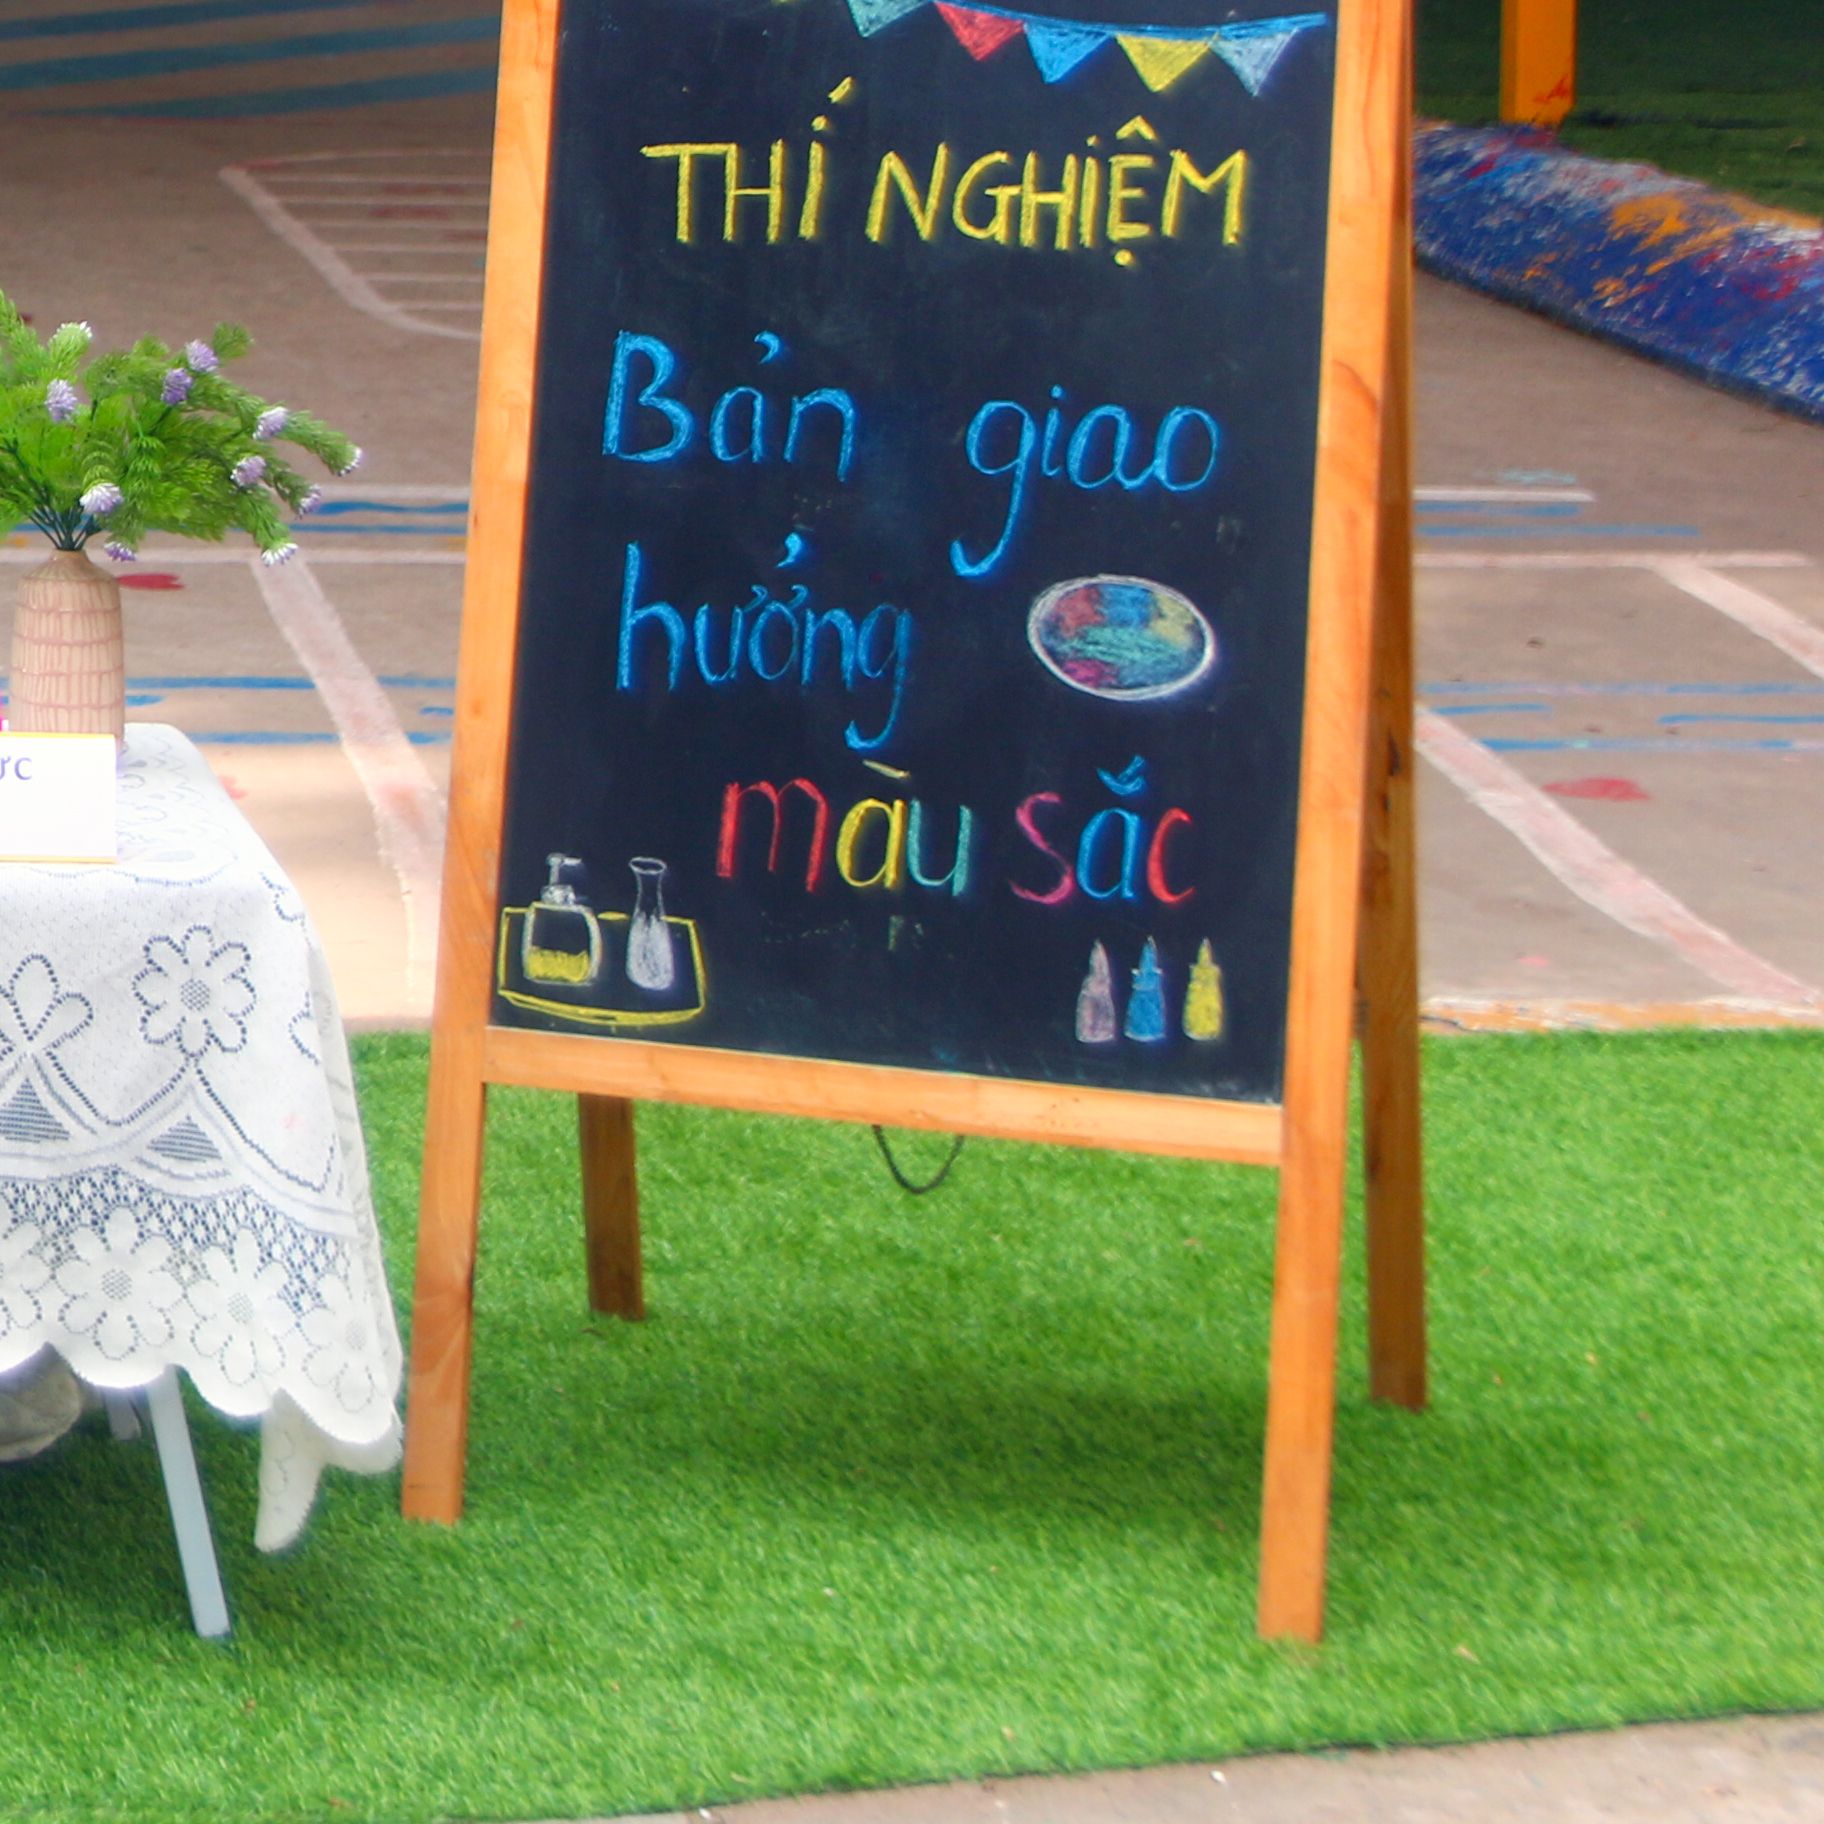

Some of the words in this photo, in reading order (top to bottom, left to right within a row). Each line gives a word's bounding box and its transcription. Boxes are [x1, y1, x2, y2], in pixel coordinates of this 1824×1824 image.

[638, 75, 854, 245] THÍ
[864, 114, 1250, 267] NGHIỆM
[601, 328, 857, 482] Bản
[950, 384, 1222, 578] giao
[615, 532, 914, 751] hưởng
[717, 759, 973, 897] màu
[1010, 756, 1194, 904] sắc
